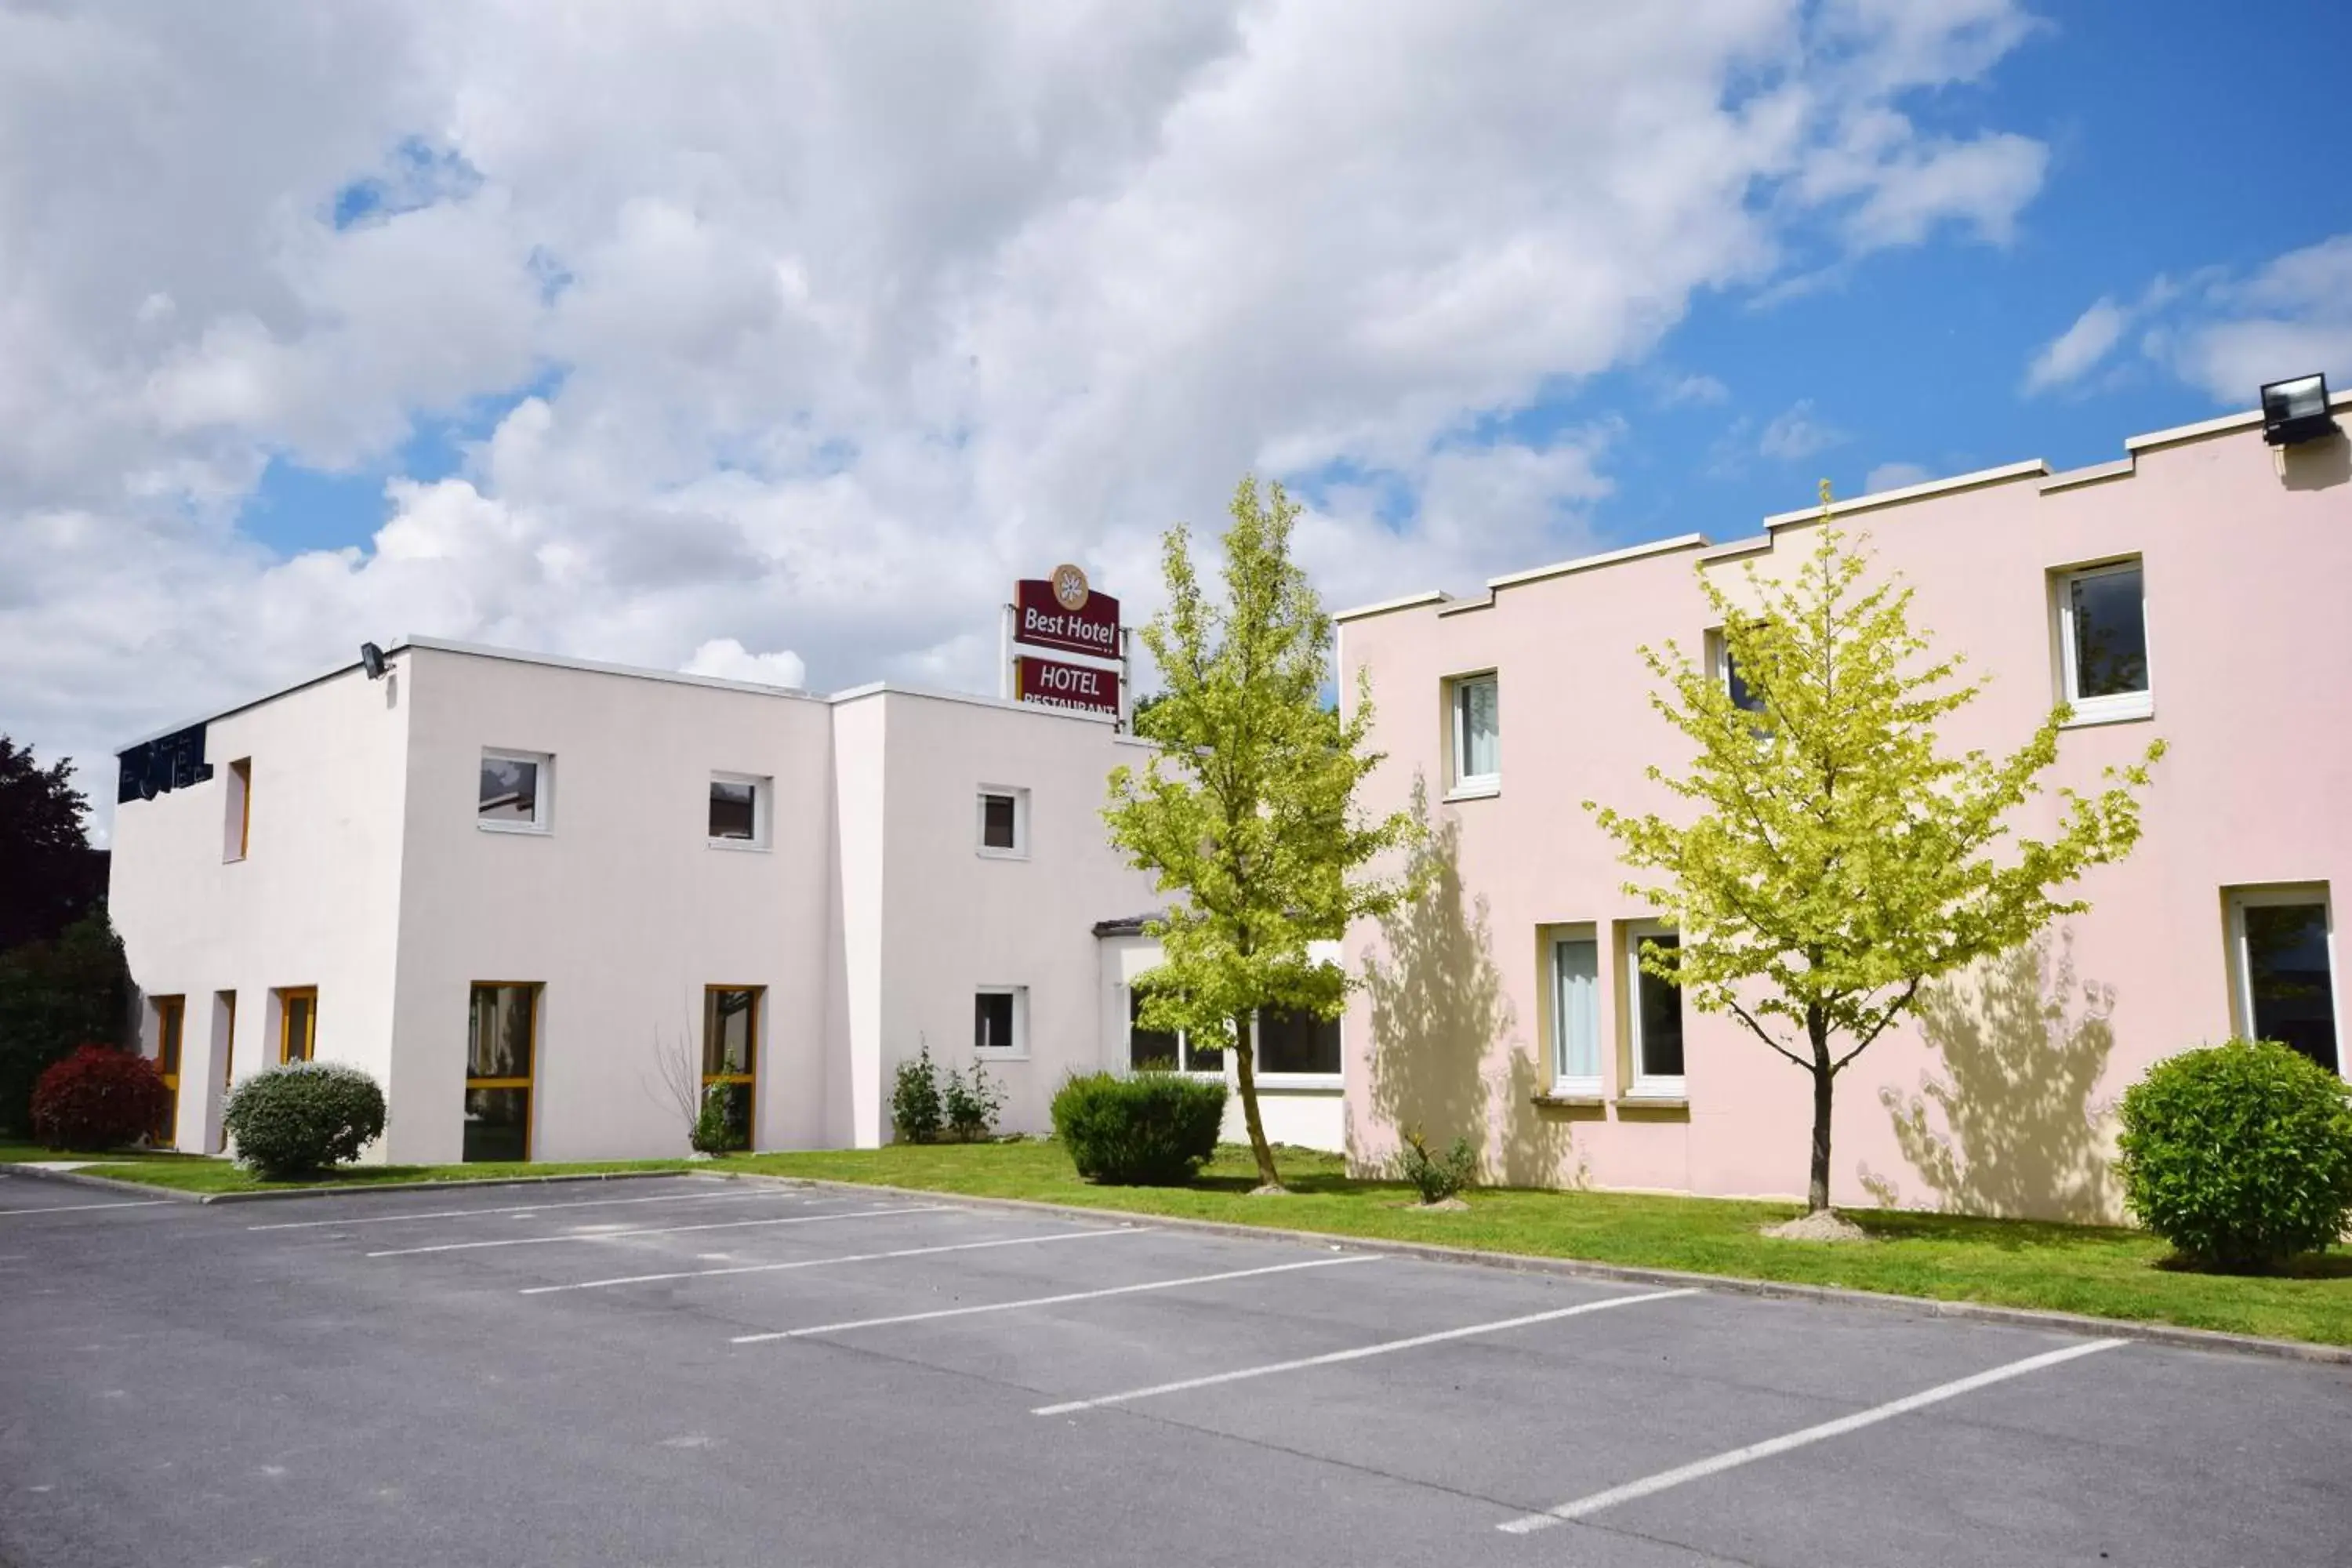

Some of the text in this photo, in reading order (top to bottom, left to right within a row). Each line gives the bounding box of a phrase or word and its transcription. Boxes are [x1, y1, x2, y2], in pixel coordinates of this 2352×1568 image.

[1025, 607, 1114, 644] Best Hotel
[1040, 665, 1100, 695] HOTEL
